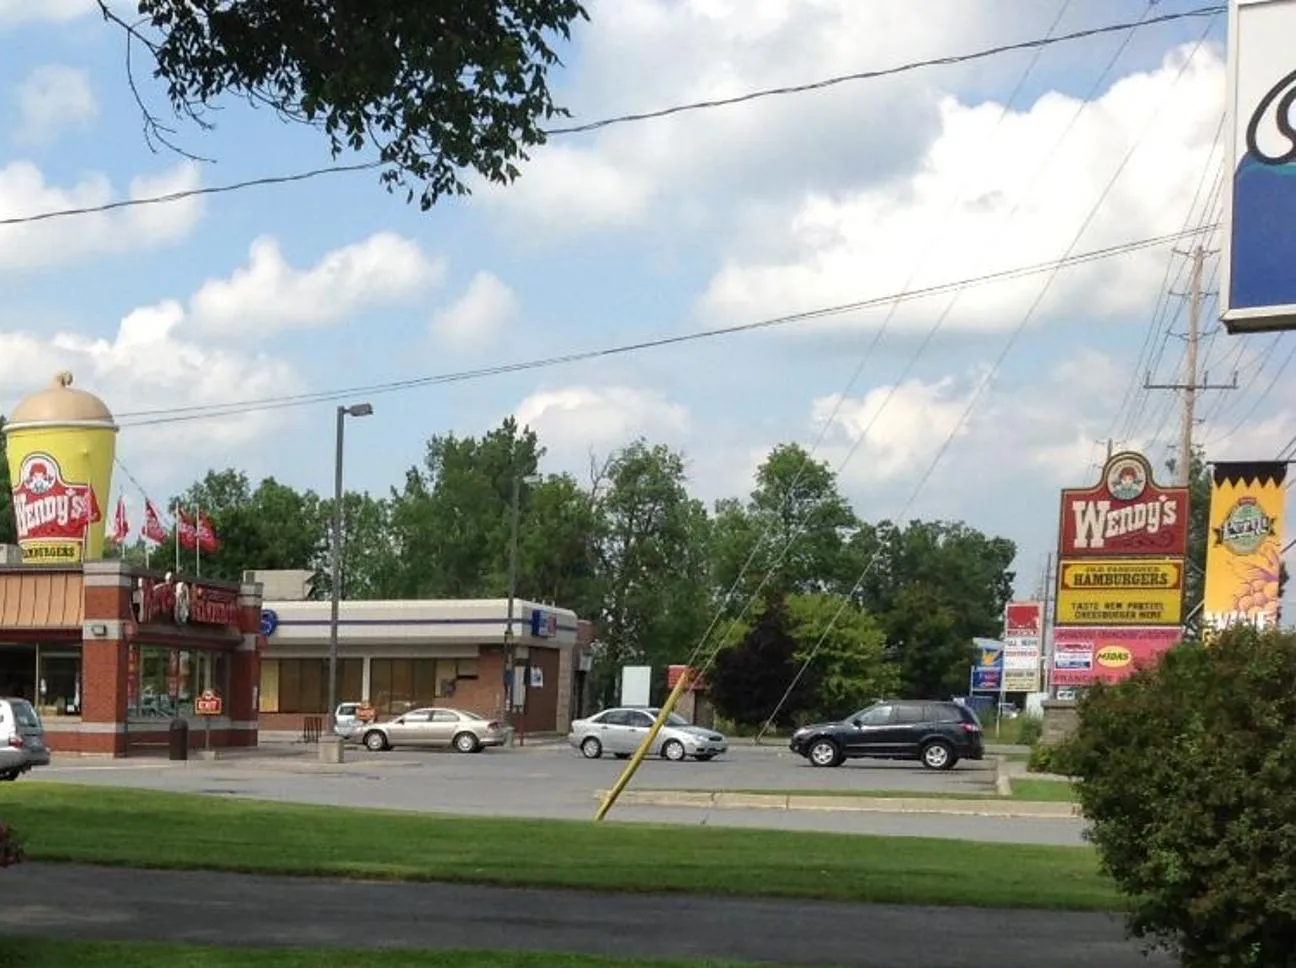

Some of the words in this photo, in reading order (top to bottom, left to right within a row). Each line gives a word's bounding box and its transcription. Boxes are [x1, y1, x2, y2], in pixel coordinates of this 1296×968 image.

[13, 489, 85, 537] Wendy's
[1072, 494, 1177, 548] Wendy's
[1073, 573, 1168, 586] HAMBURGERS
[1096, 652, 1129, 661] MIDAS
